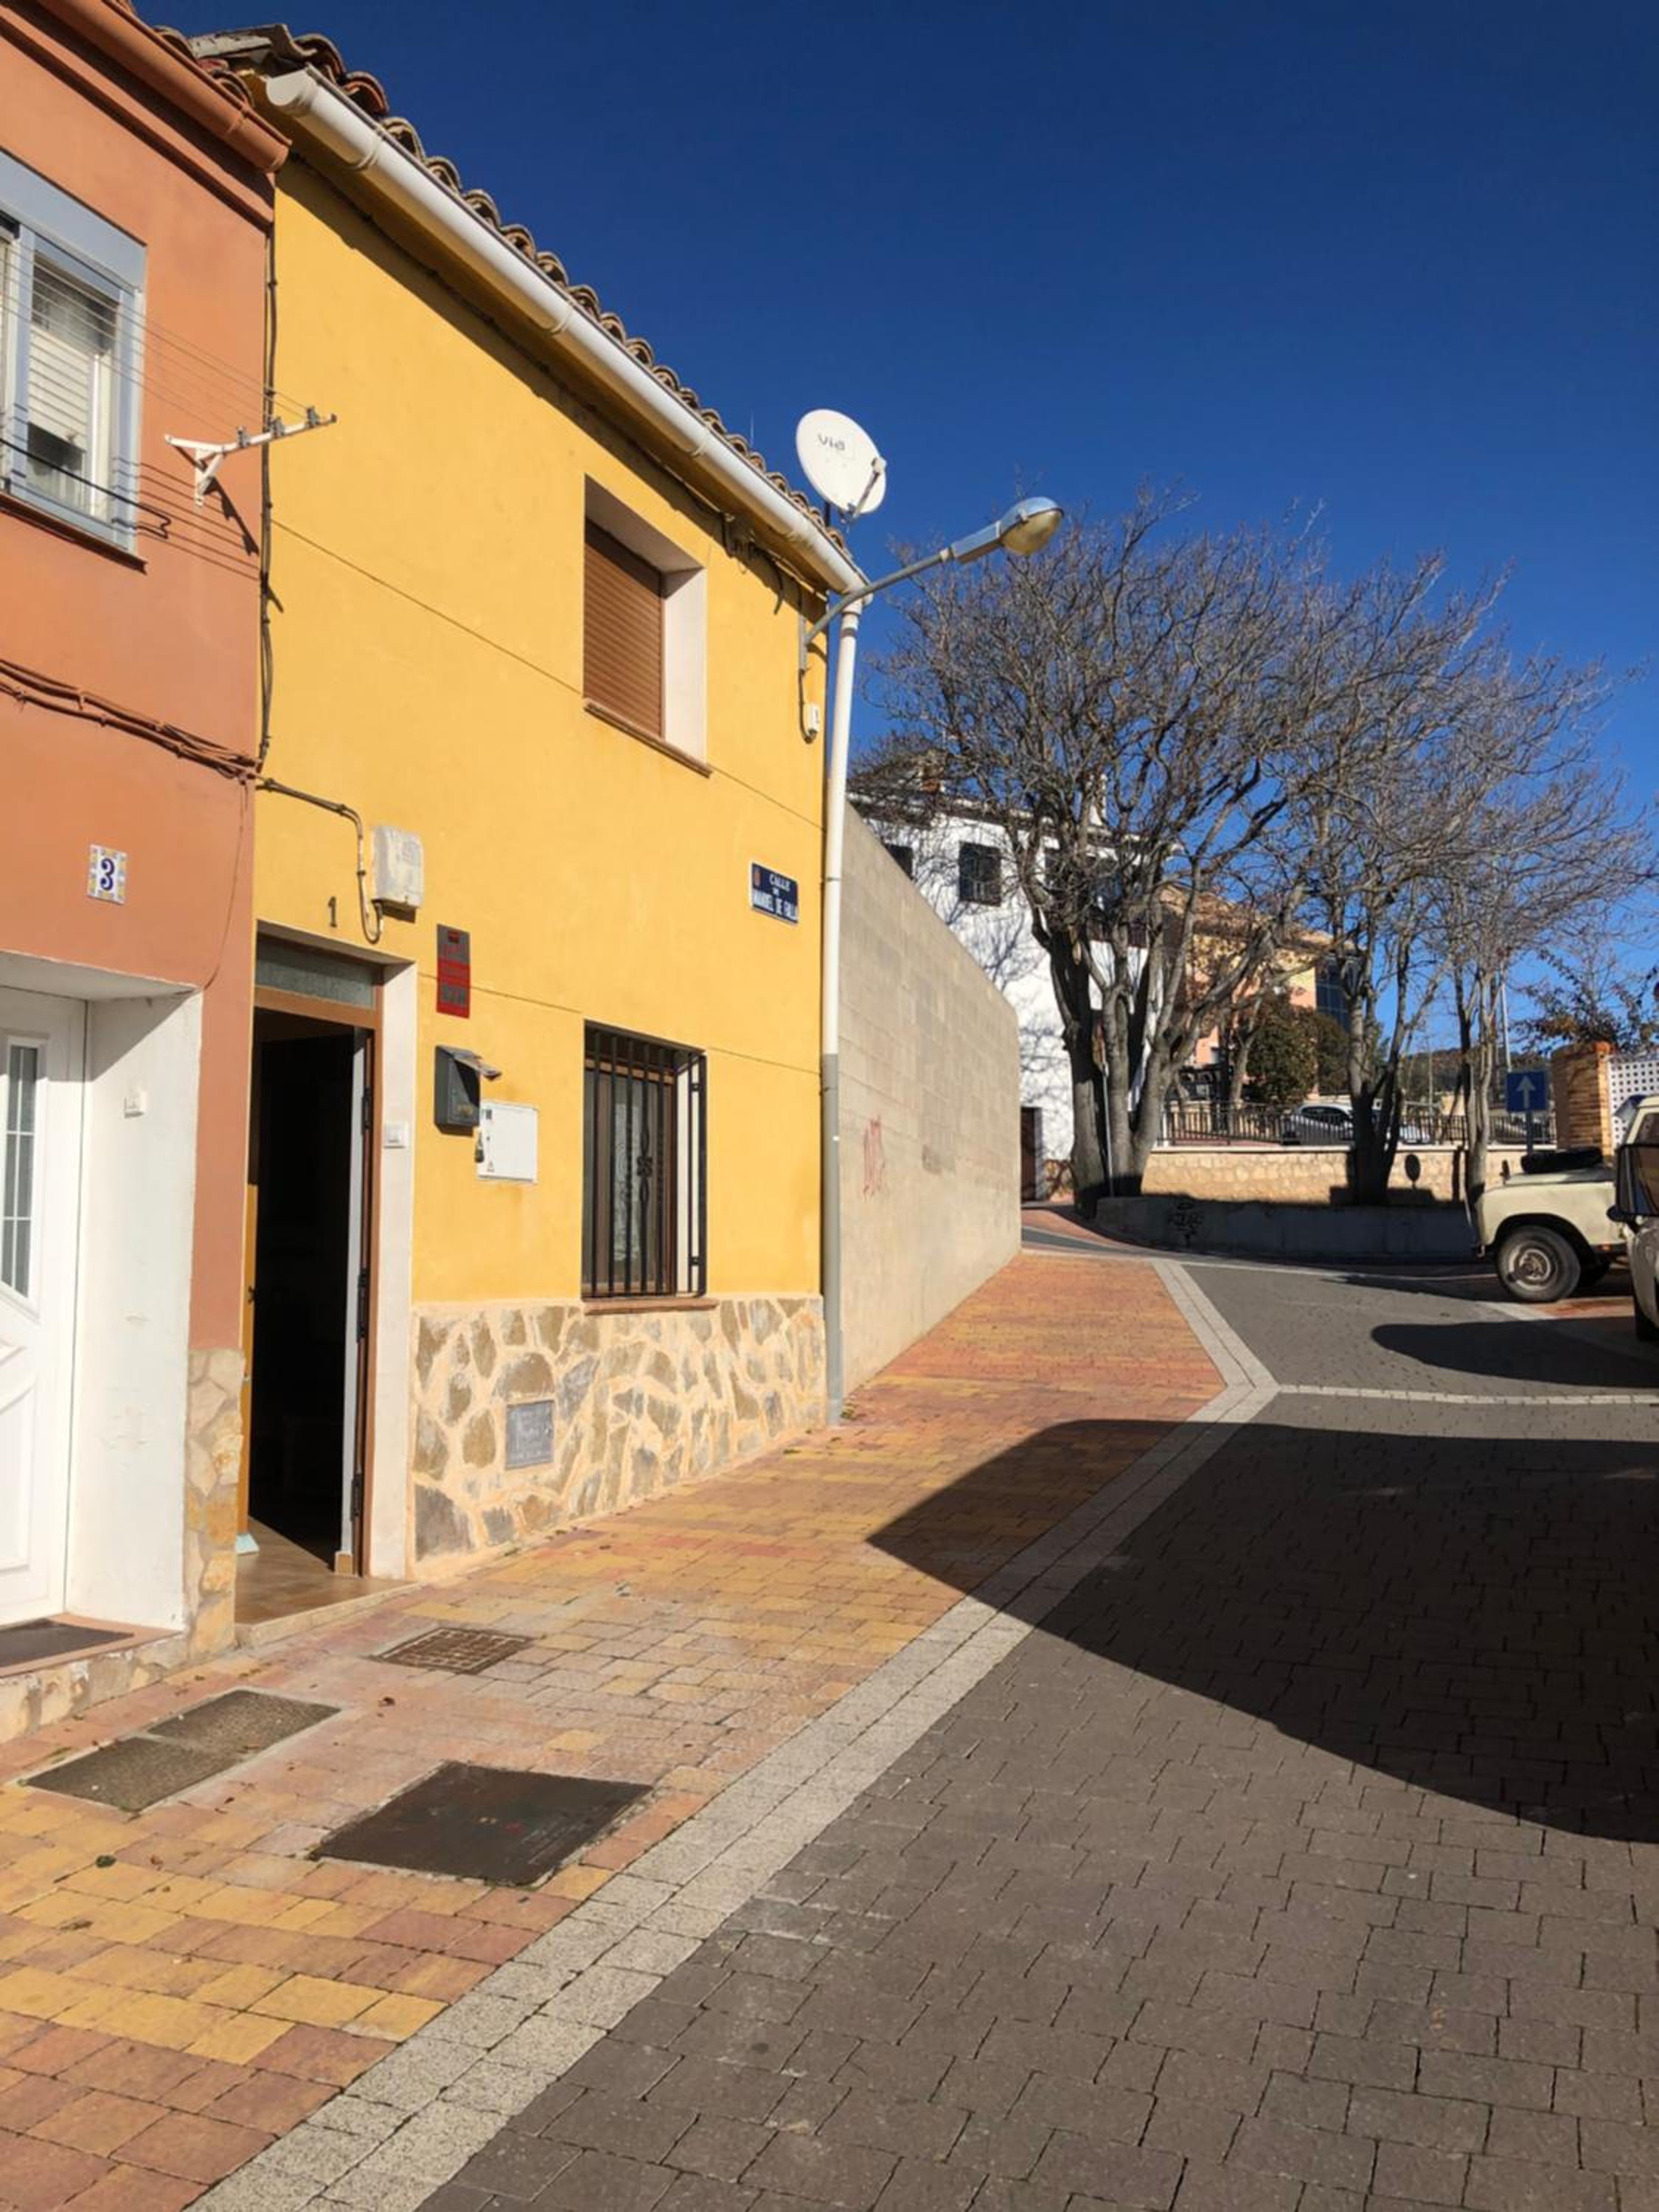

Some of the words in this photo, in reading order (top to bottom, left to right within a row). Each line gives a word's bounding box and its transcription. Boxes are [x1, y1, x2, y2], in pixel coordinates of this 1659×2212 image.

[100, 858, 115, 891] 3
[769, 873, 790, 892] CALLE
[327, 897, 337, 928] 1
